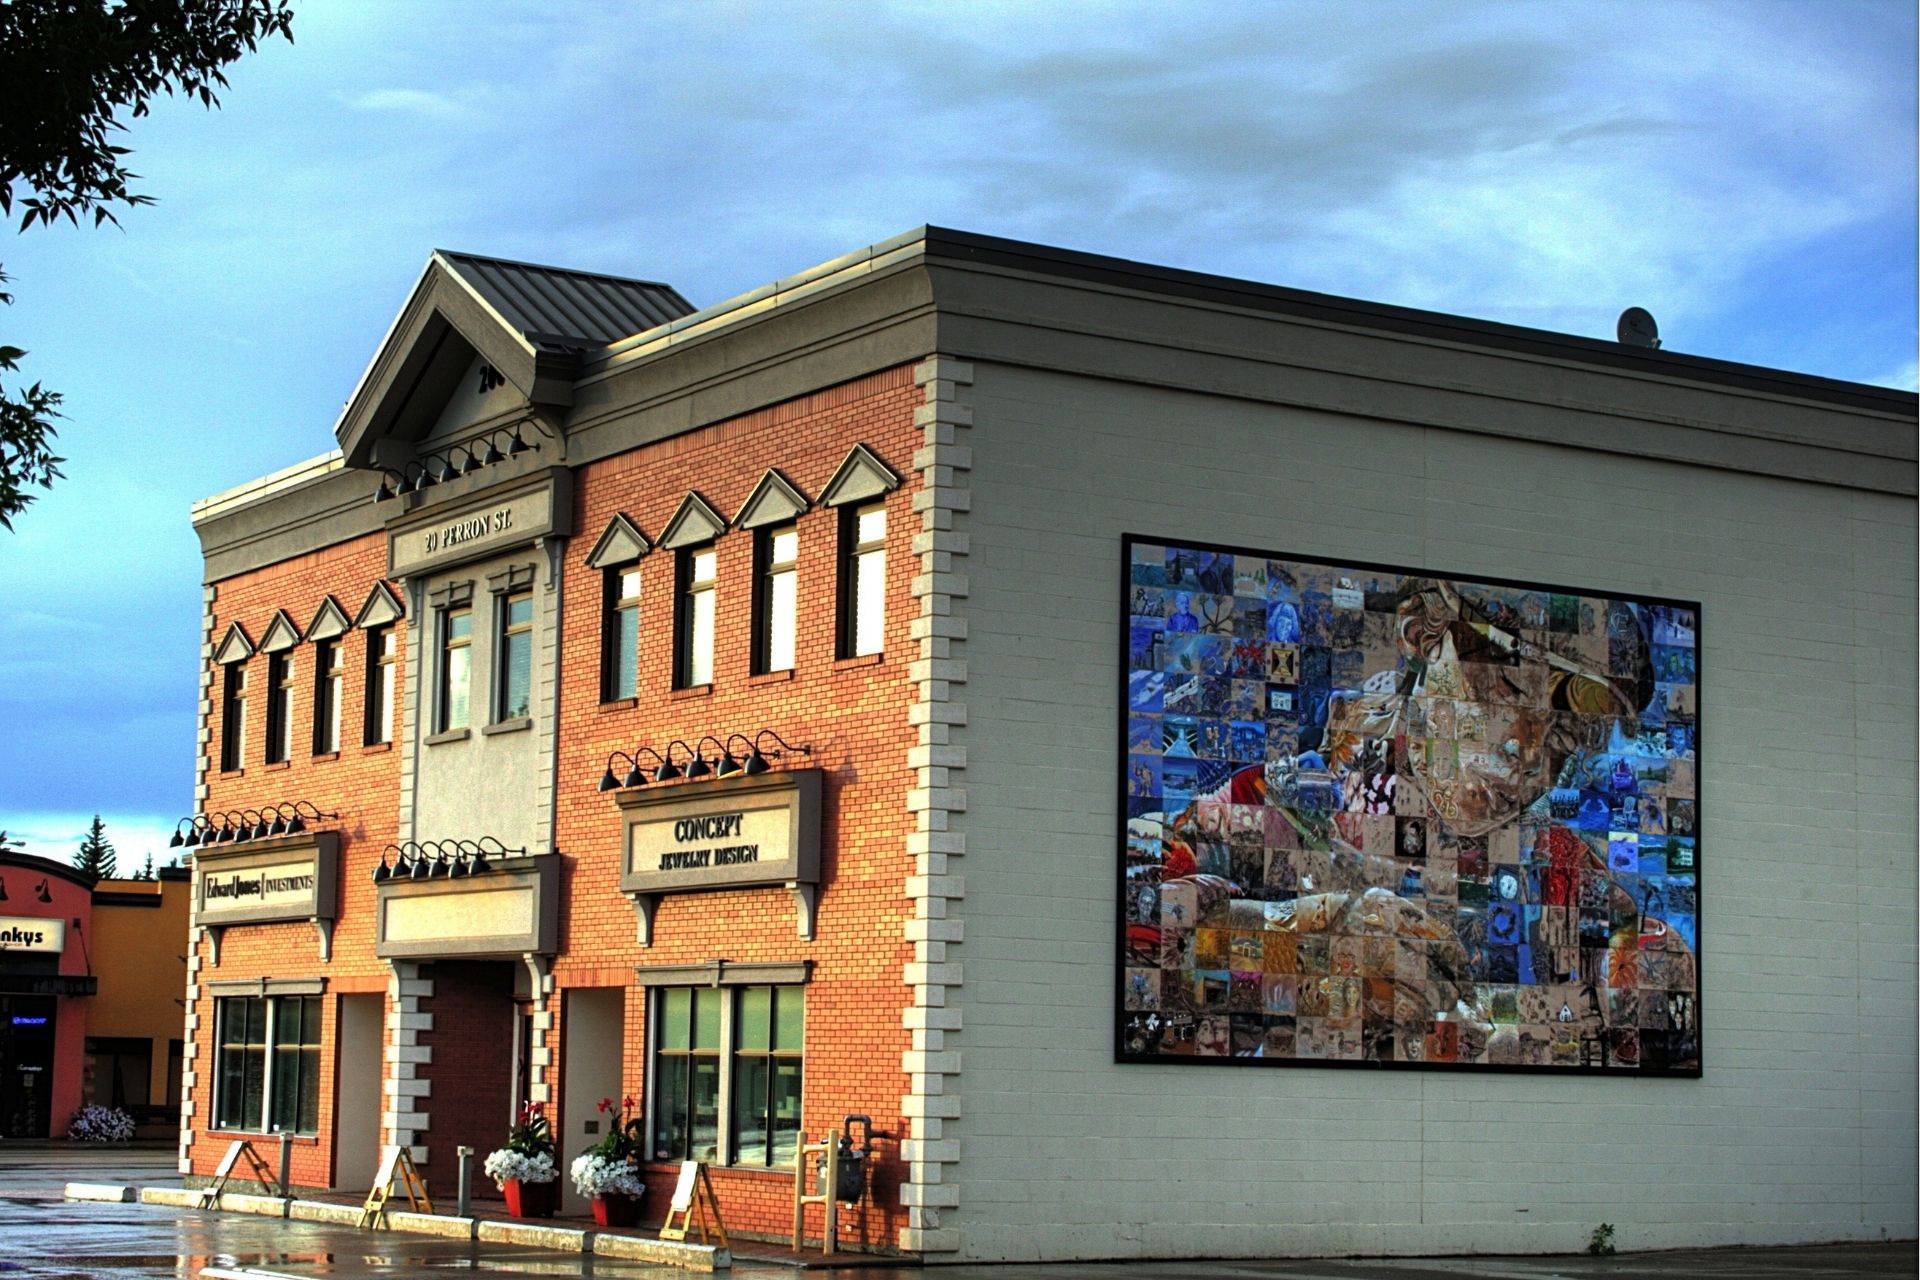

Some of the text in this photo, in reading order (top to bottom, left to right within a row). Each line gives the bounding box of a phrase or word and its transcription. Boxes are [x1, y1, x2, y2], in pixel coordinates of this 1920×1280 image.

[425, 508, 513, 553] 20 PERRON ST.
[674, 813, 744, 843] CONCEPT
[658, 844, 759, 871] JEWELRY DESIGN
[265, 874, 314, 893] INVESTMENTS
